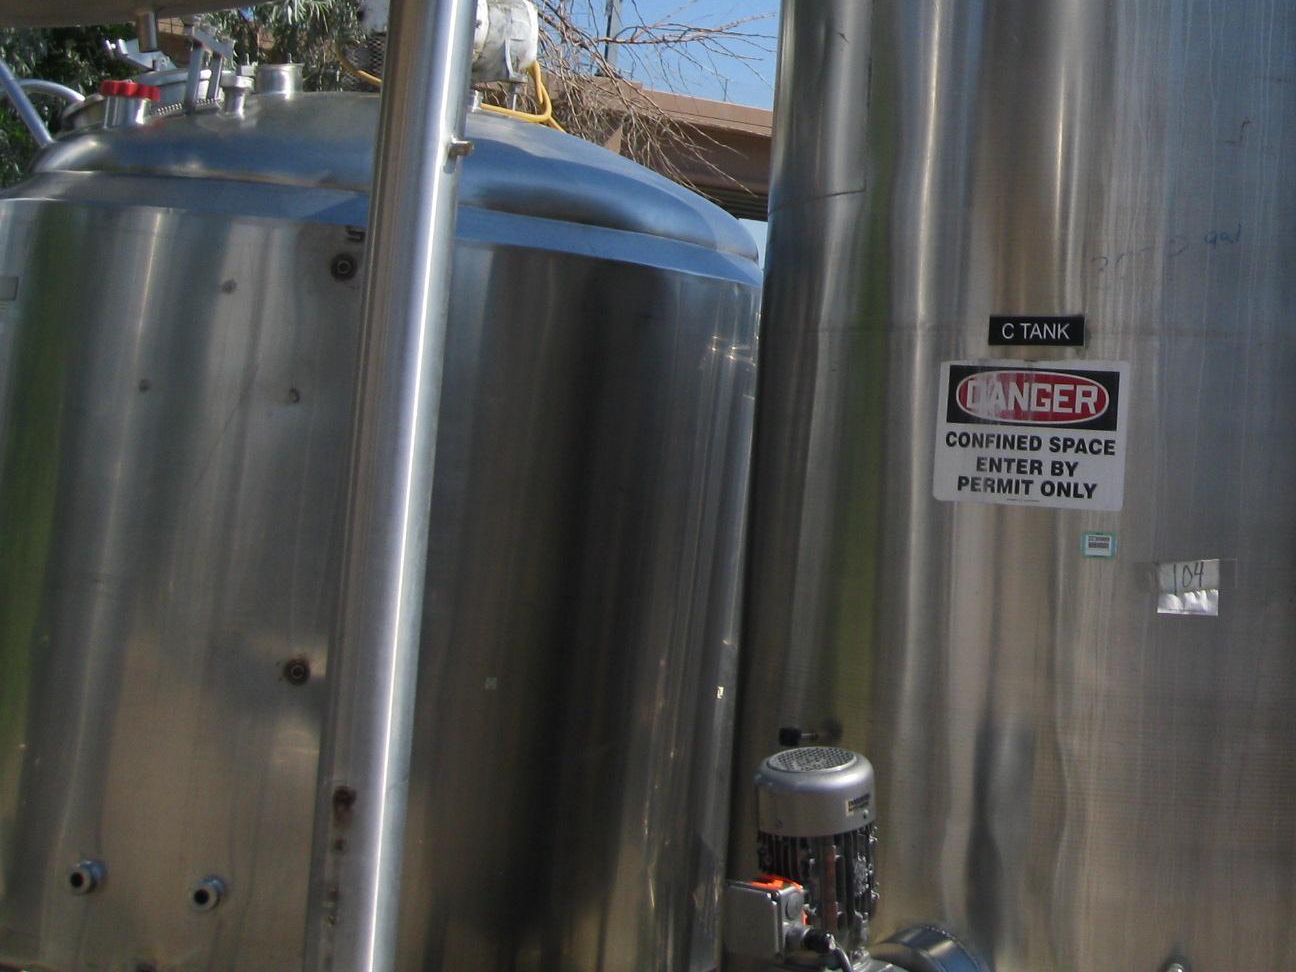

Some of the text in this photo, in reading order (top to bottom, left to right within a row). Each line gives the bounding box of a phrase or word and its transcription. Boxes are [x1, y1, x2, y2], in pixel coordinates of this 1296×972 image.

[1002, 322, 1070, 339] C TANK
[966, 379, 1097, 415] DANGER
[946, 431, 1116, 456] CONFINED SPACE
[976, 456, 1079, 477] ENTER BY
[957, 475, 1098, 500] PERMIT ONLY
